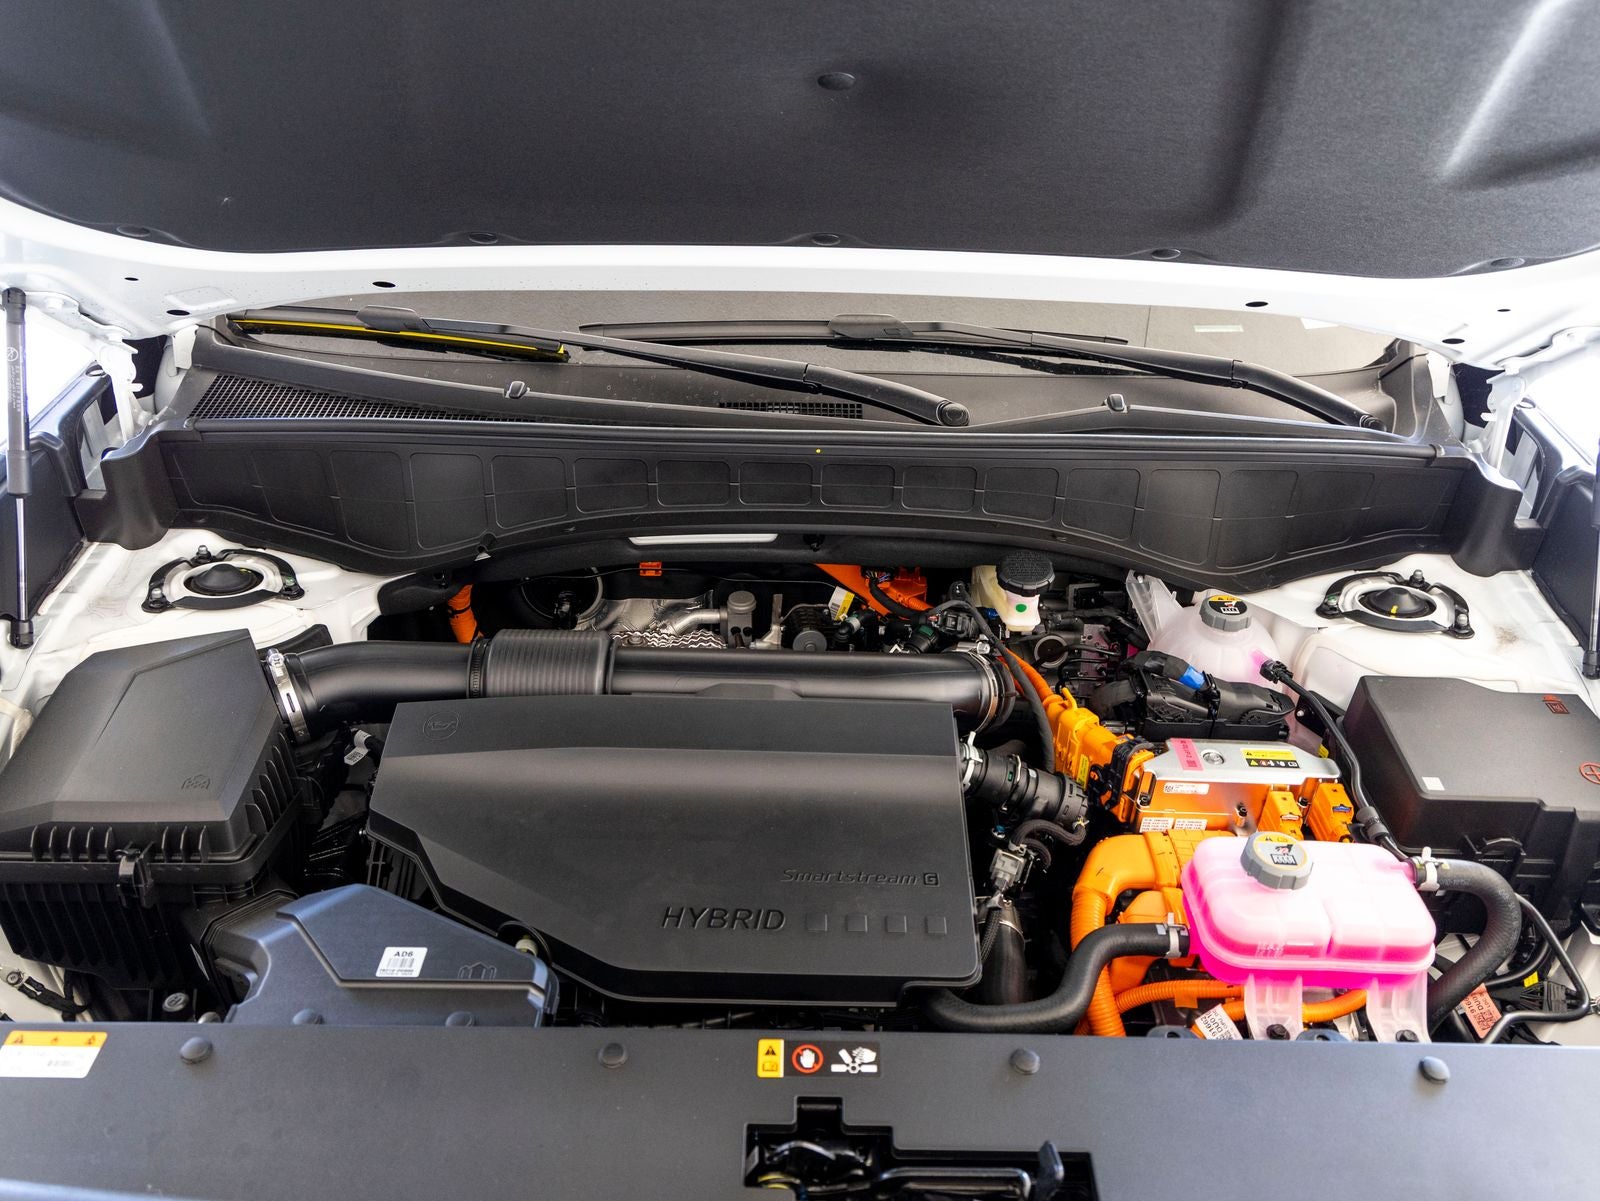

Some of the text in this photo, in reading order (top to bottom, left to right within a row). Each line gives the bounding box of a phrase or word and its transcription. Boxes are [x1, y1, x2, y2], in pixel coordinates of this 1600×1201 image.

[781, 869, 939, 886] Smartstream G
[660, 906, 786, 931] HYBRID
